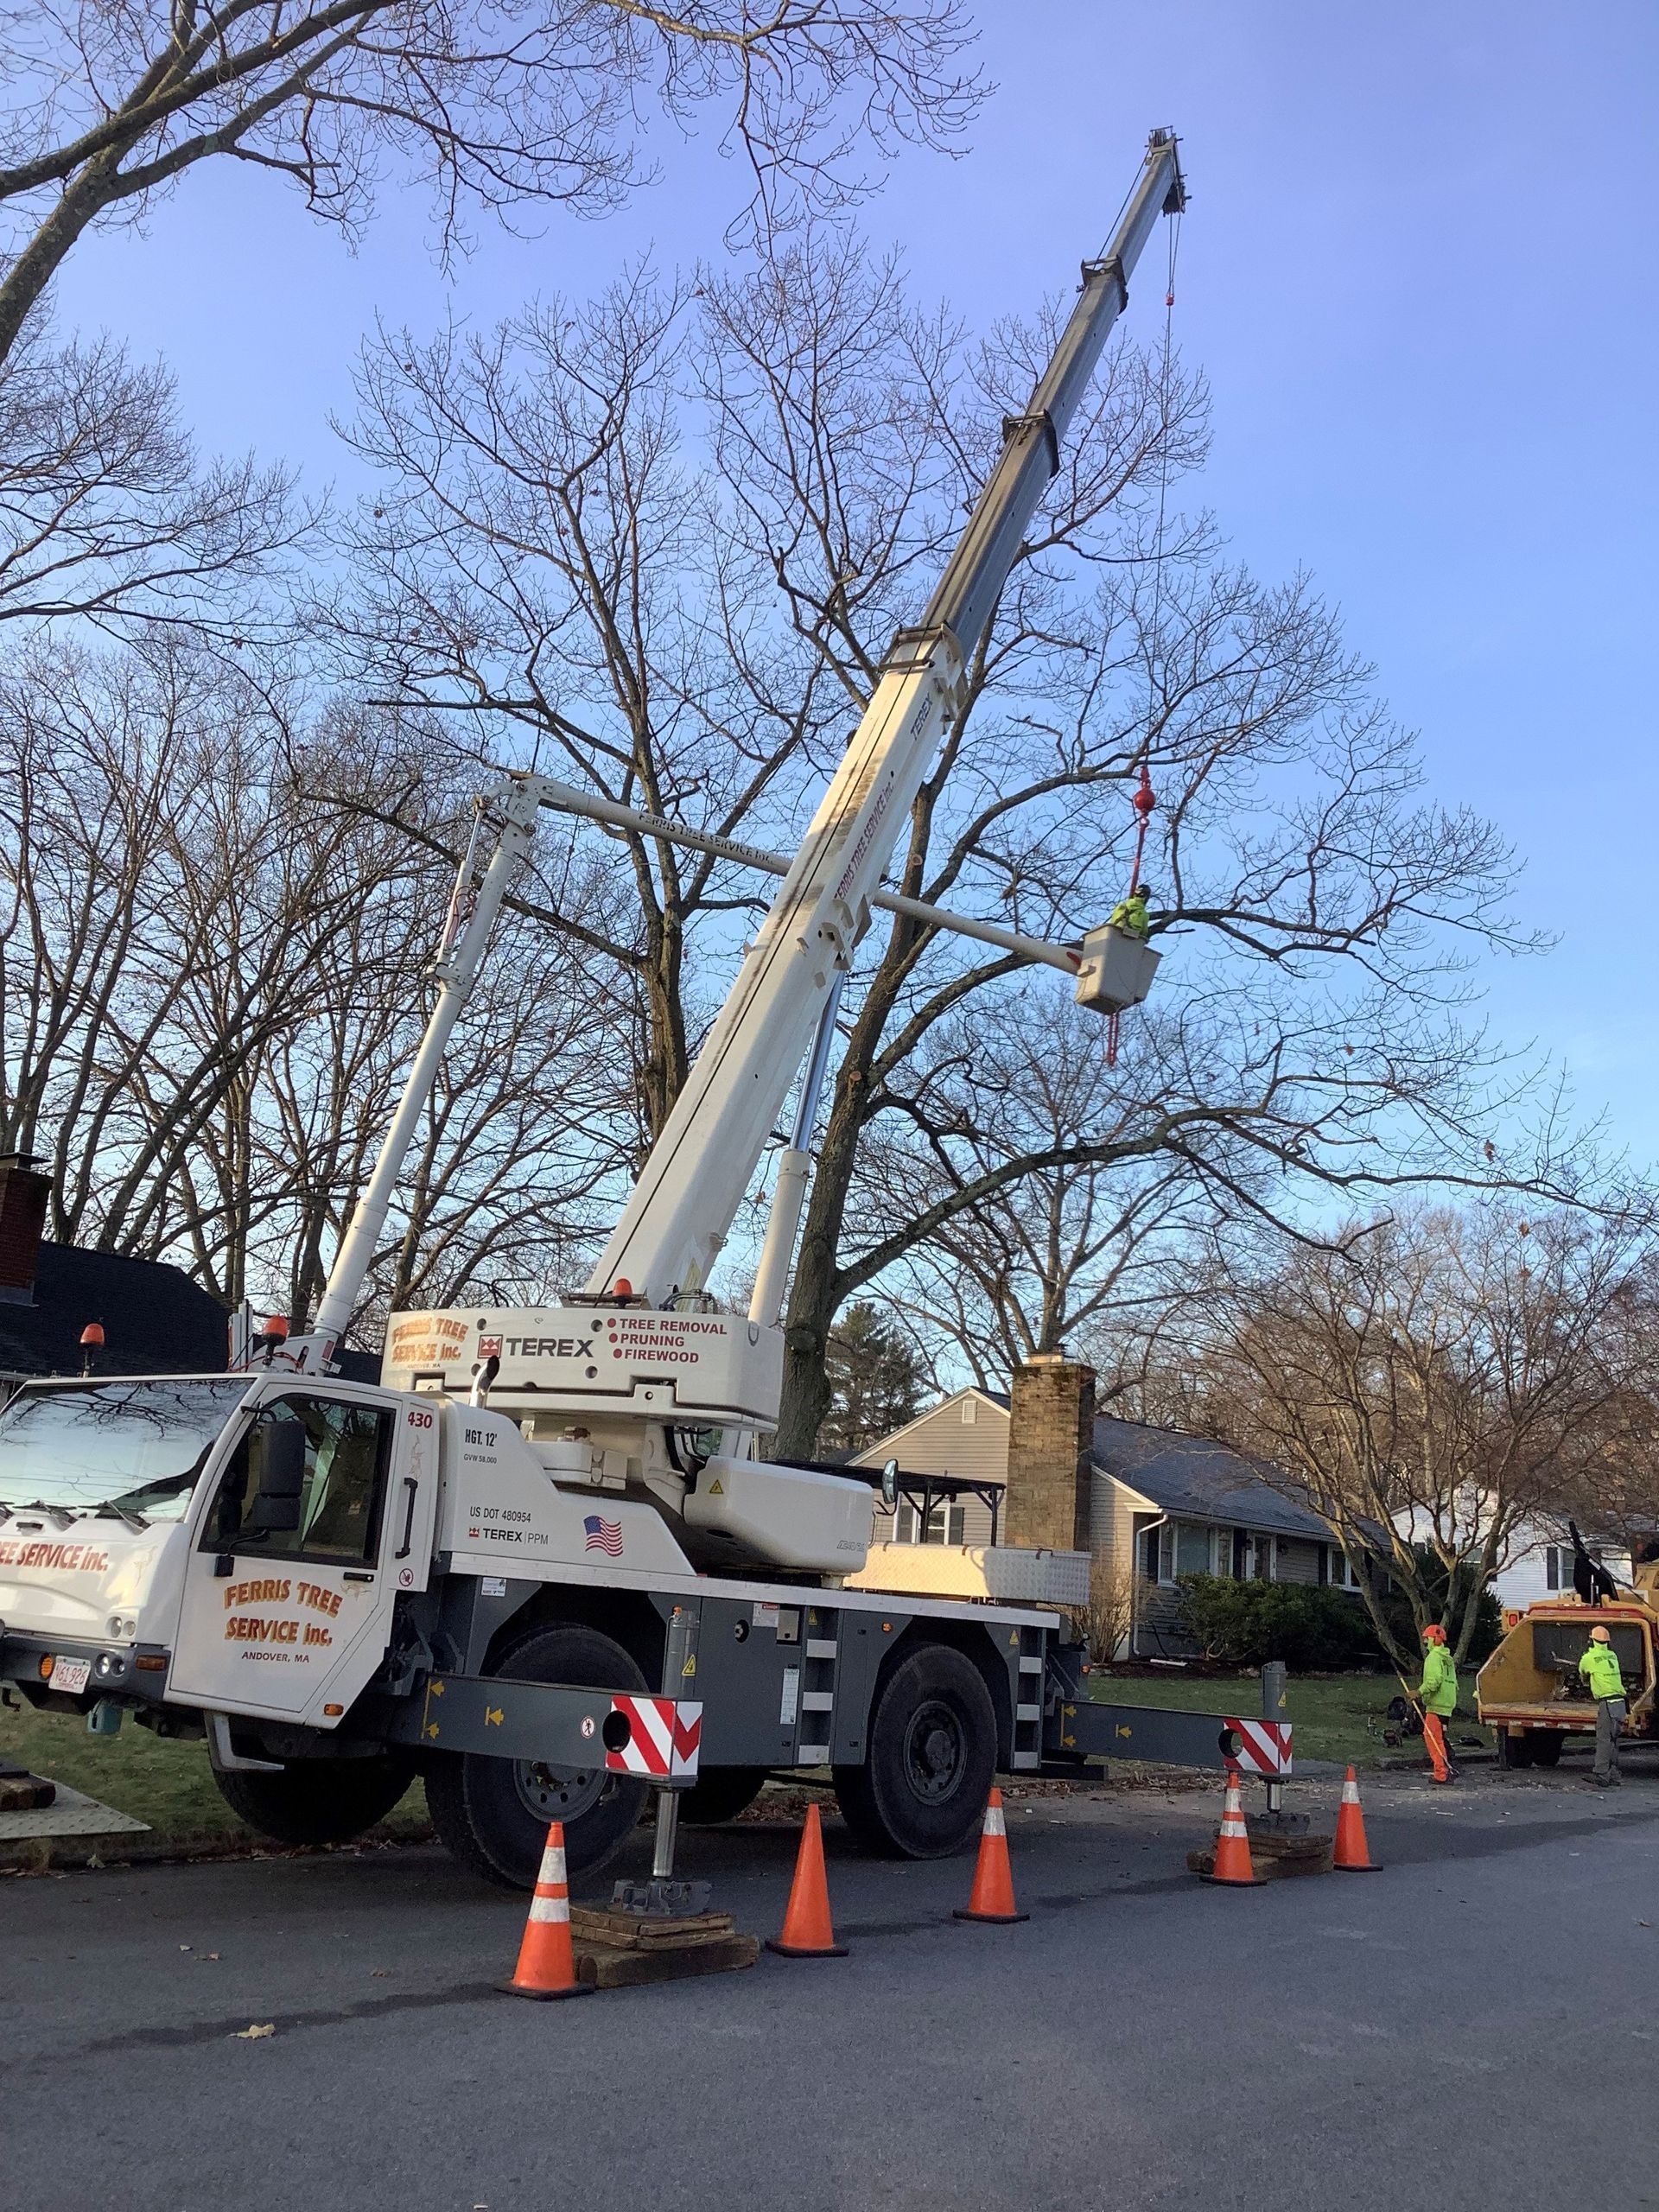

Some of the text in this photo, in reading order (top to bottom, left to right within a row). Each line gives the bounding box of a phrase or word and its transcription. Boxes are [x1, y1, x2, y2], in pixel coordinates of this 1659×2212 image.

[911, 693, 933, 741] TEREX
[850, 836, 868, 869] TREE
[863, 794, 886, 843] SERVICE
[435, 1318, 469, 1343] TREE
[620, 1319, 728, 1335] TREE REMOVAL
[506, 1338, 594, 1357] TEREX
[620, 1333, 684, 1347] PRUNING
[439, 1343, 461, 1361] inc.
[625, 1349, 699, 1363] FIREWOOD
[408, 1412, 432, 1428] 430
[465, 1428, 498, 1447] HGT. 12'
[463, 1453, 478, 1462] GVW
[470, 1506, 531, 1522] US DOT 480954
[483, 1528, 549, 1545] TEREX PPM
[16, 1543, 84, 1569] SERVICE
[79, 1546, 108, 1571] inc.
[224, 1580, 343, 1618] FERRIS TREE
[224, 1617, 333, 1647] SERVICE inc.
[241, 1651, 309, 1663] ANDOVER, MA
